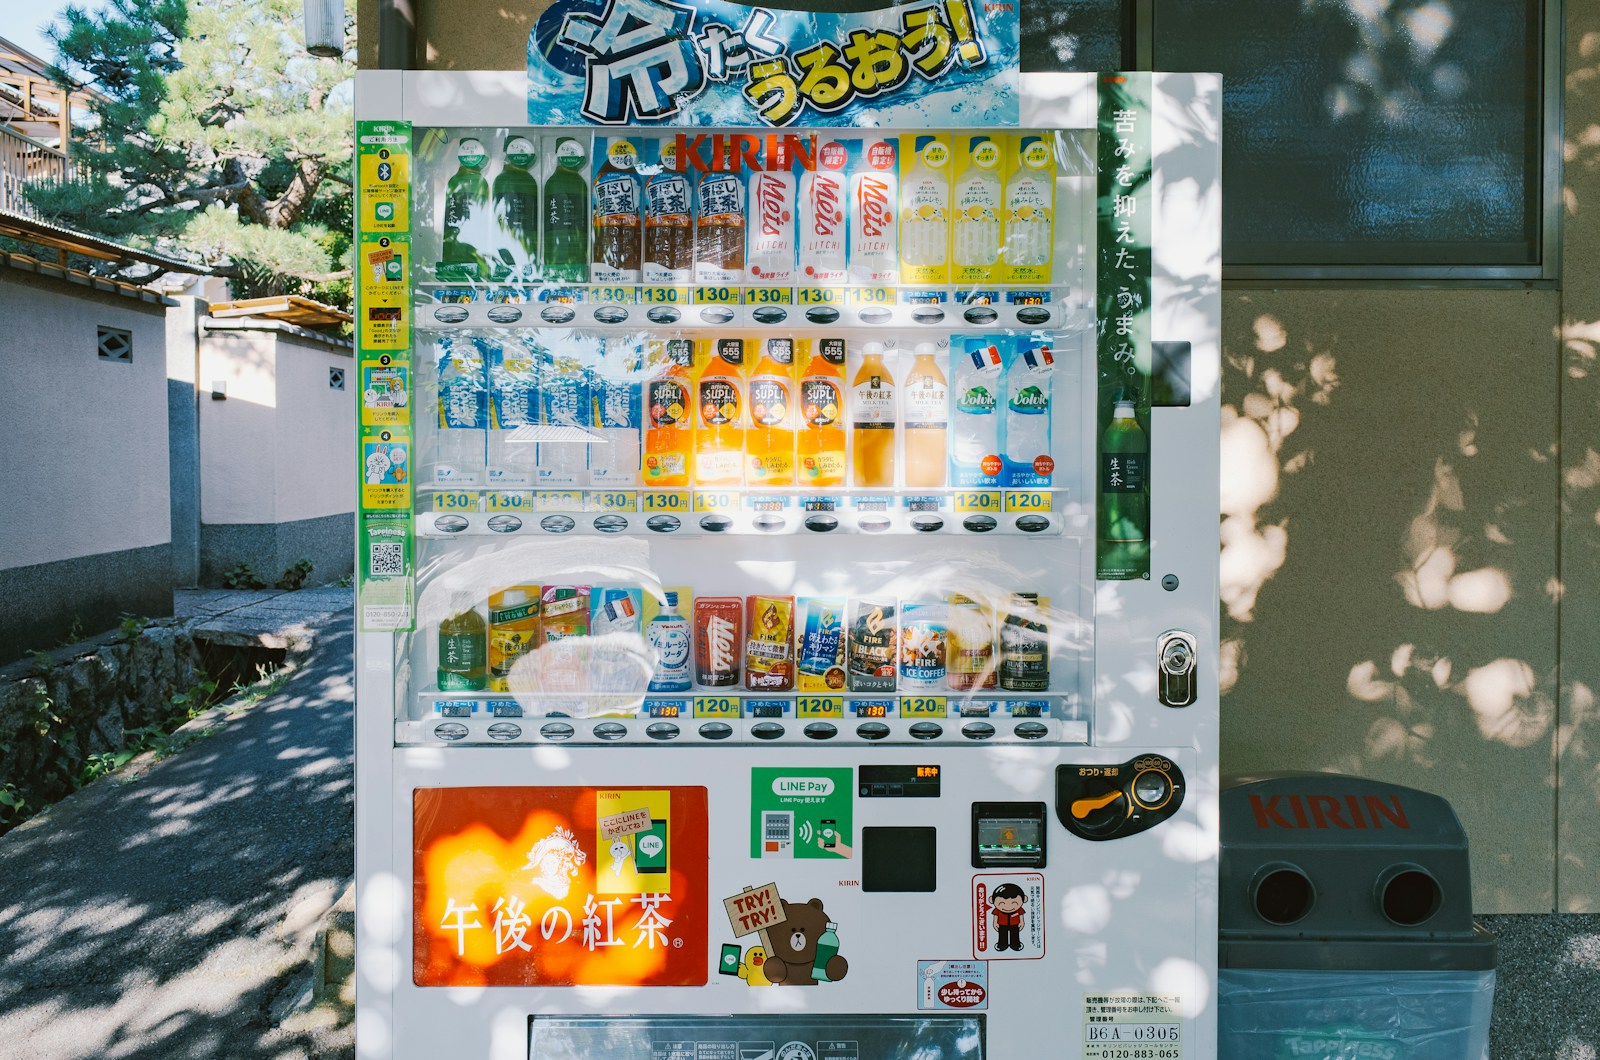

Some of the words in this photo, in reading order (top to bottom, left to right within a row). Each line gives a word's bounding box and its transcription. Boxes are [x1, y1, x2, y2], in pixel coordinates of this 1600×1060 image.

[984, 3, 1014, 12] KIRIN
[558, 0, 786, 122] 冷たく
[746, 0, 986, 126] うるおう!
[675, 134, 818, 171] KIRIN
[823, 146, 844, 155] 自販機
[871, 146, 891, 155] 自販機
[824, 156, 843, 165] 限定!
[871, 156, 891, 165] 限定!
[763, 174, 787, 235] Mets
[815, 174, 839, 236] Mets
[863, 175, 889, 237] Mets
[549, 198, 560, 224] 生茶
[382, 238, 388, 246] 2
[756, 240, 788, 251] LITCHI
[809, 240, 840, 251] LITCHI
[858, 241, 890, 252] LITCHI
[1113, 109, 1137, 375] 苦みを抑えた、うまみ。
[644, 287, 687, 302] 130円
[695, 287, 738, 301] 130円
[747, 288, 790, 302] 130円
[800, 288, 843, 302] 130円
[852, 288, 895, 302] 130円
[722, 347, 740, 355] 555
[824, 347, 843, 355] 555
[382, 356, 388, 364] 3
[705, 389, 735, 399] SUPLI
[755, 389, 784, 399] SUPLI
[807, 389, 835, 399] SUPLI
[858, 390, 892, 400] 午後の紅茶
[911, 390, 945, 400] 午後の紅茶
[961, 393, 996, 405] Volvic
[1013, 393, 1048, 405] Volvic
[1110, 457, 1123, 486] 生茶
[435, 494, 477, 508] 130円
[488, 494, 531, 508] 130円
[646, 494, 688, 508] 130円
[957, 494, 999, 508] 120円
[1009, 494, 1051, 508] 120円
[760, 633, 777, 641] FIRE
[818, 628, 833, 636] FIRE
[863, 635, 882, 643] FIRE
[447, 639, 459, 663] 生茶
[664, 649, 683, 658] ソーダ
[808, 643, 836, 652] キリマン
[858, 645, 887, 656] BLACK
[914, 658, 937, 667] FIRE
[906, 668, 917, 678] ICE
[918, 667, 945, 678] COFFEE
[652, 706, 678, 716] ¥130
[696, 699, 739, 713] 120円
[799, 699, 842, 713] 120円
[858, 706, 885, 716] ¥130
[902, 699, 945, 713] 120円
[916, 767, 938, 777] 販売中
[1078, 768, 1119, 777] おつり・返却
[780, 782, 806, 791] LINE
[808, 782, 828, 793] Pay
[1248, 794, 1411, 829] KIRIN
[603, 811, 647, 827] ここにLINEを
[607, 821, 645, 835] かざしてね!
[733, 889, 771, 914] TRY!
[440, 892, 673, 956] 午後の紅茶
[739, 905, 777, 931] TRY!
[1088, 1025, 1178, 1041] B6A-0305
[1102, 1049, 1179, 1059] 0120-883-065
